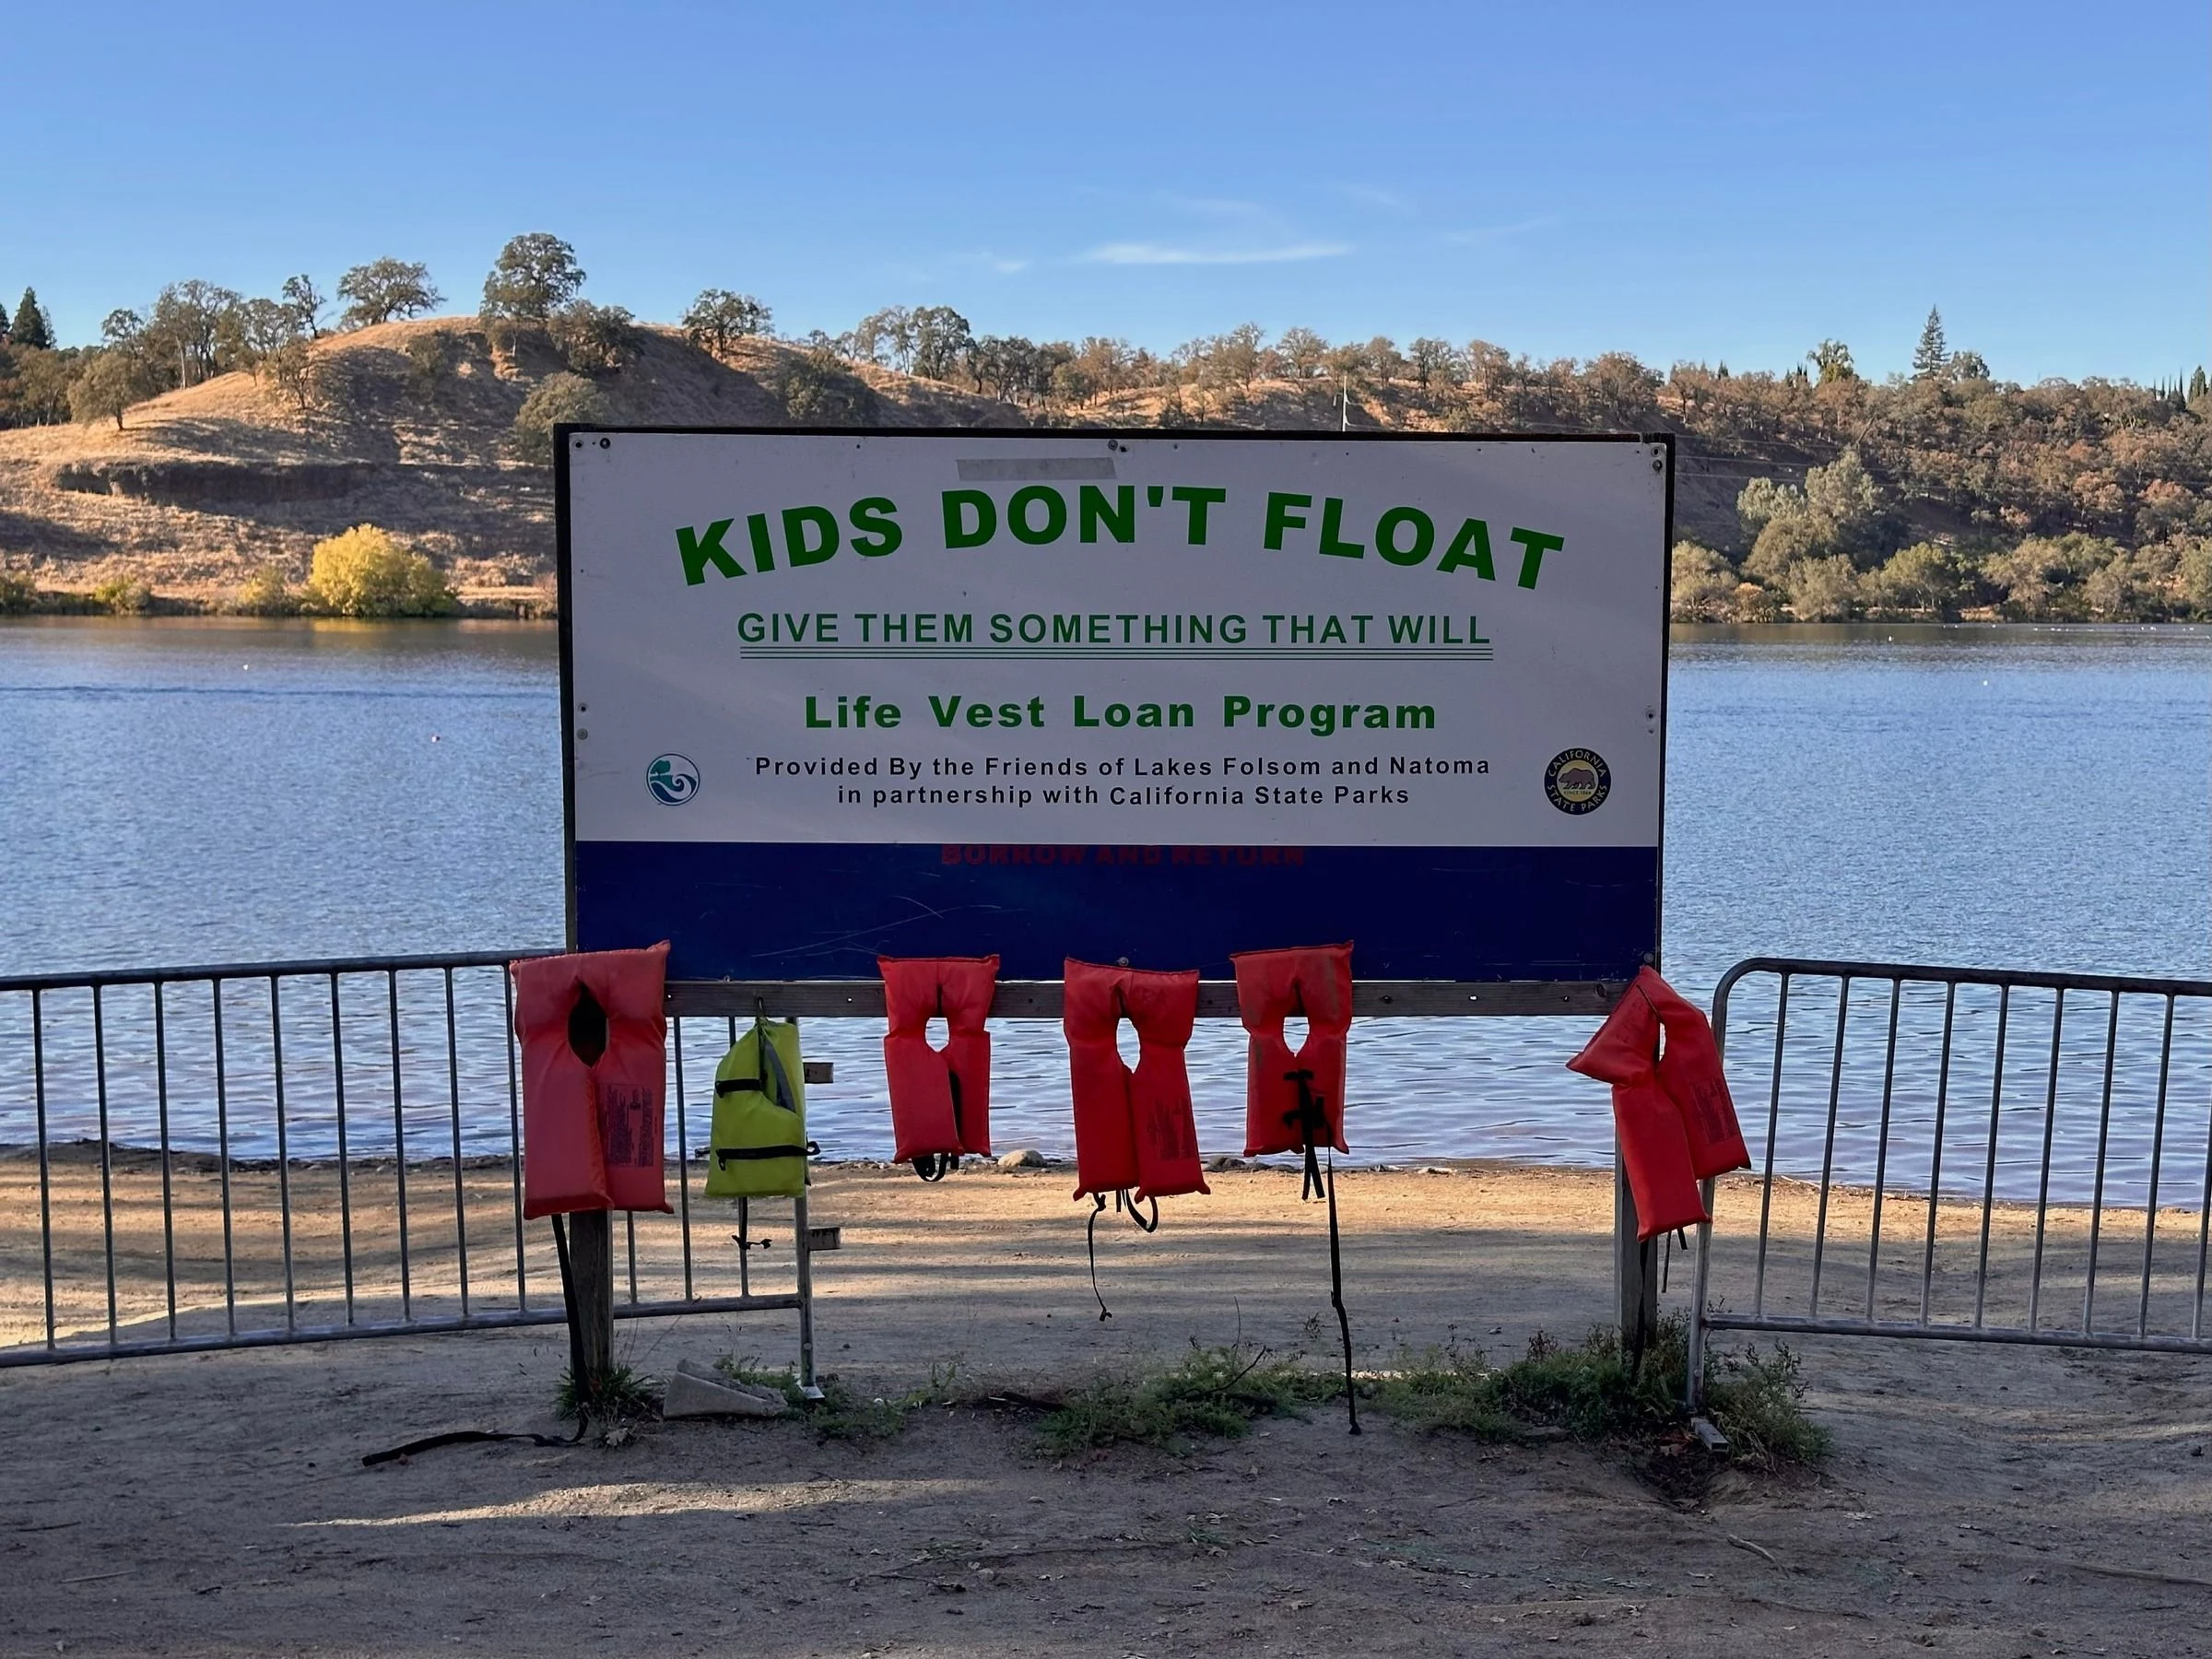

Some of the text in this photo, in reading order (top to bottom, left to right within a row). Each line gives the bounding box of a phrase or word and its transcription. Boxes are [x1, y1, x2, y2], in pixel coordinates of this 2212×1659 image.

[677, 484, 1565, 590] KIDS DON'T FLOAT
[737, 612, 1490, 643] GIVE THEM SOMETHING THAT WILL
[805, 695, 1436, 737] Life Vest Loan Program
[755, 756, 1490, 780] Provided By the Friends of Lakes Folsom and Natoma
[1548, 750, 1606, 777] CALIFORNIA
[838, 784, 1410, 808] in partnership with California State Parks
[1547, 785, 1606, 811] STATE PARKS
[941, 845, 1305, 866] BORROW AND RETURN
